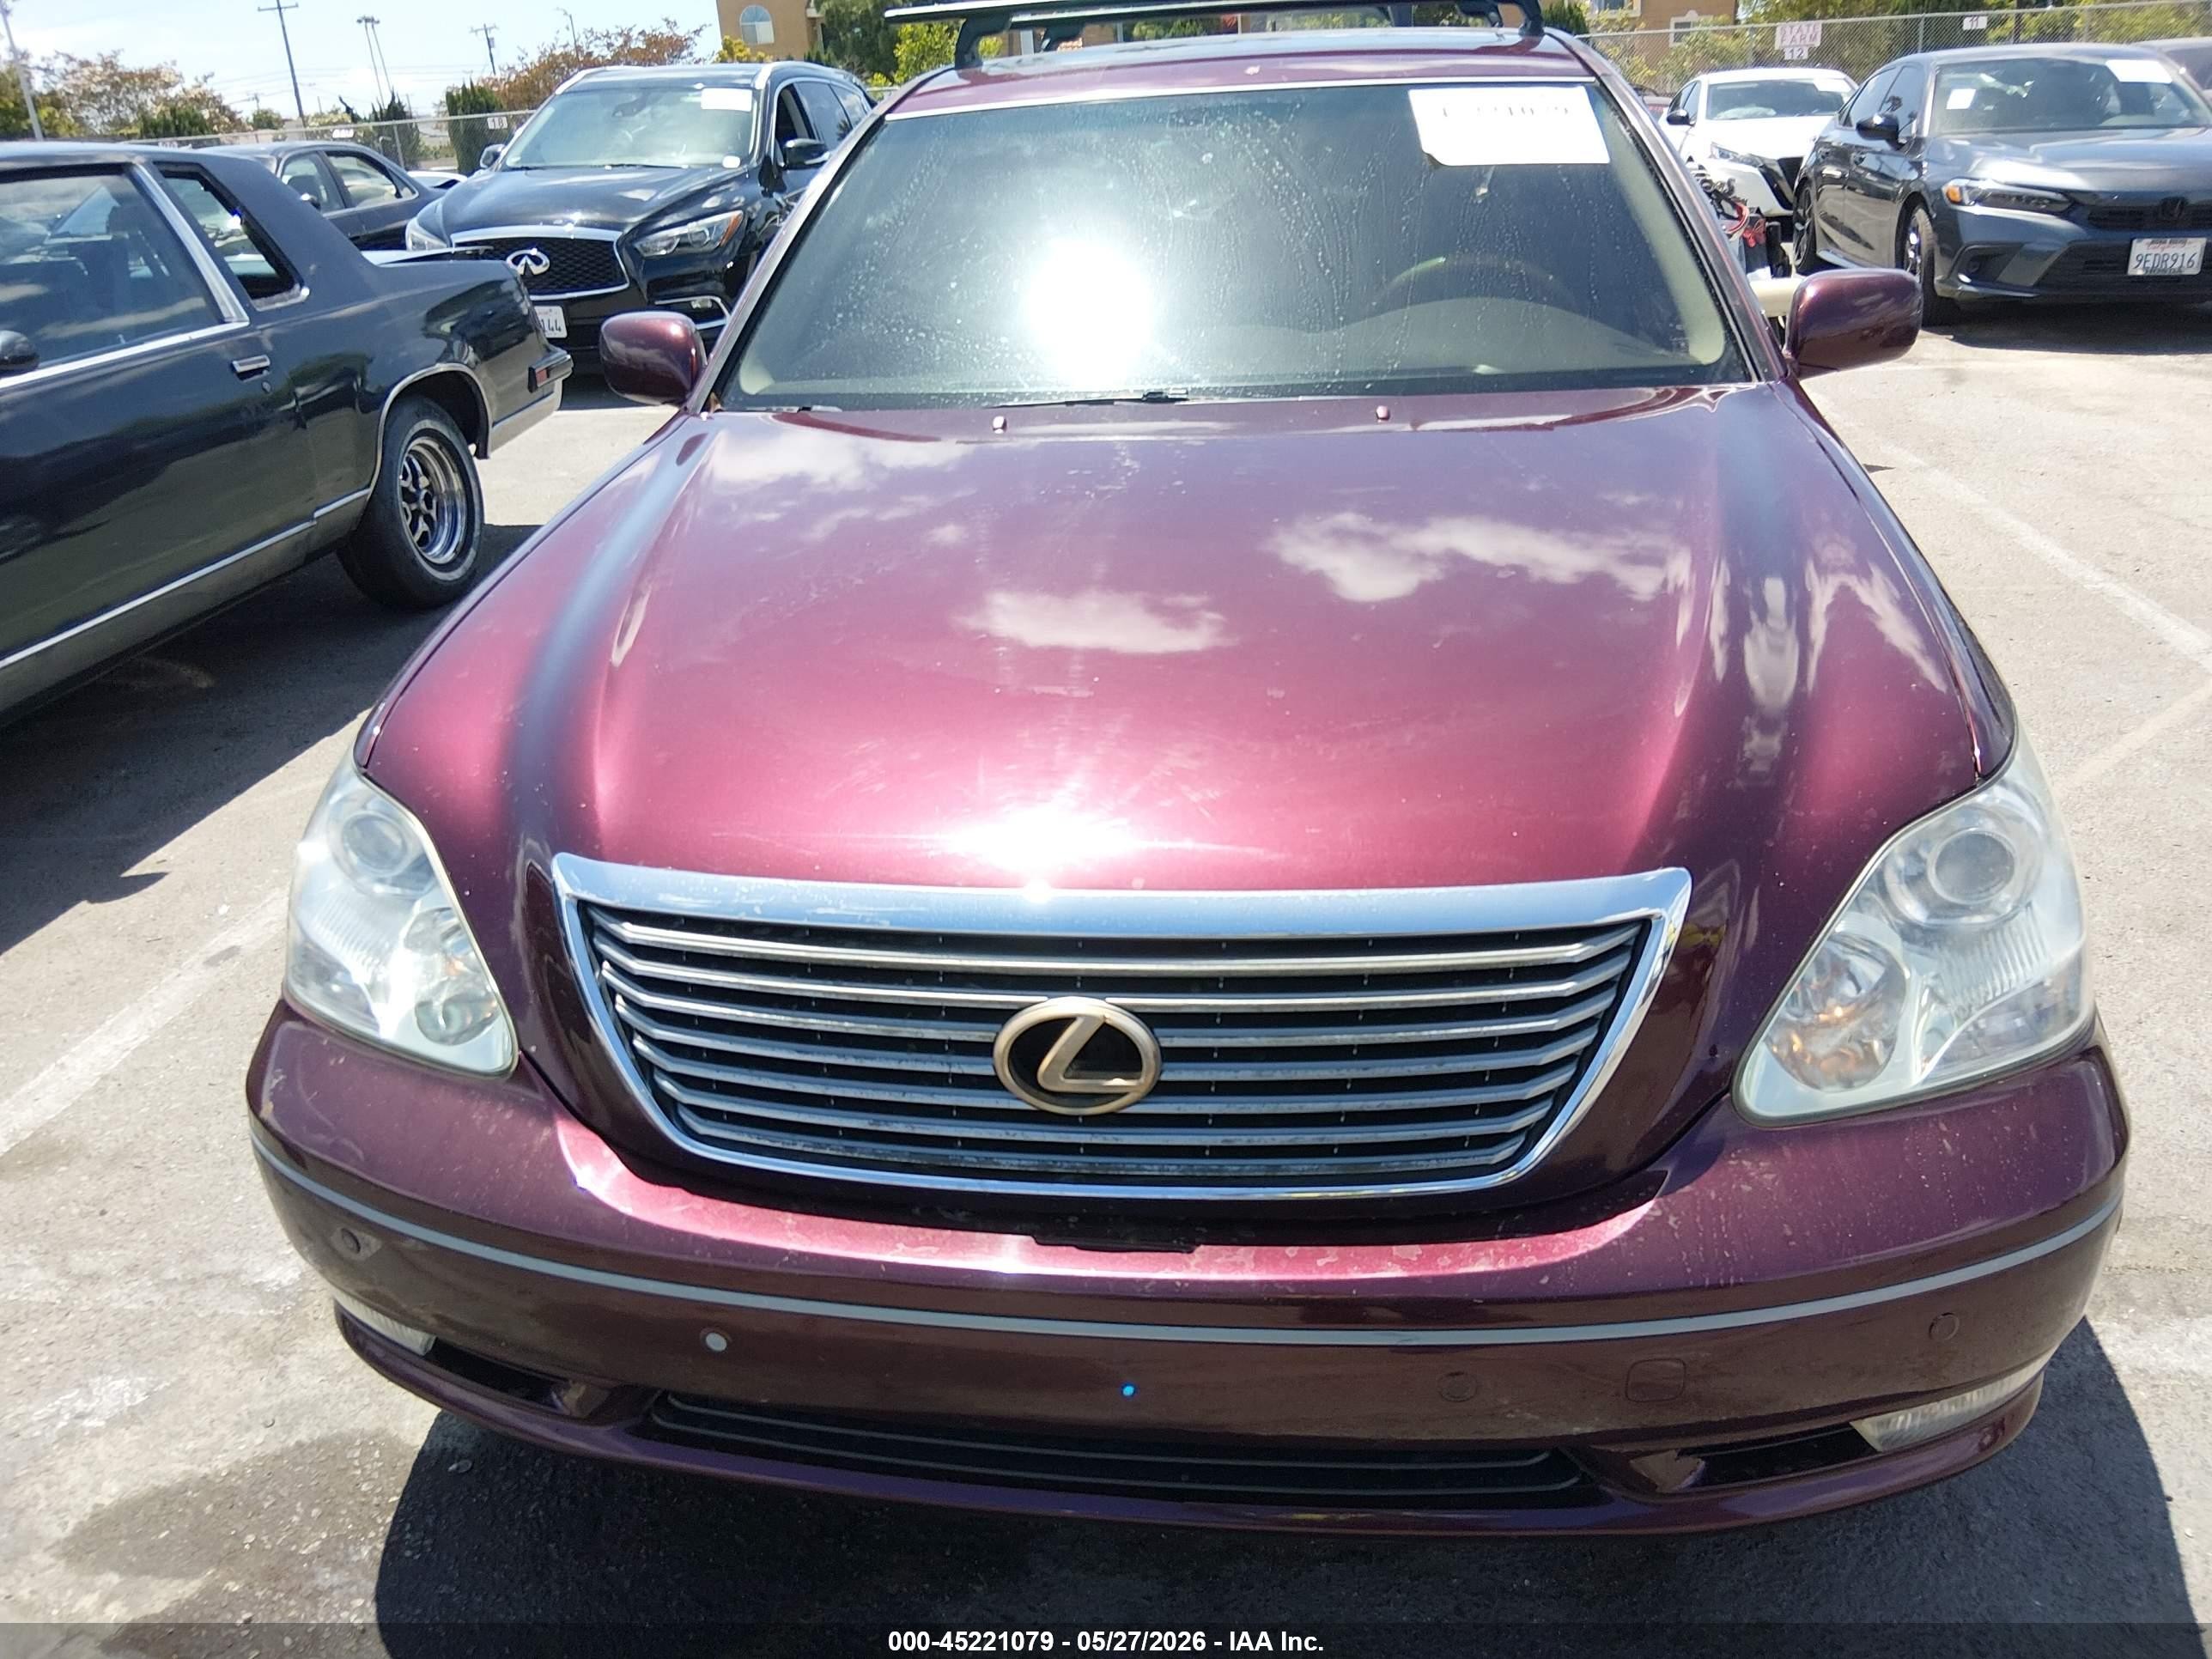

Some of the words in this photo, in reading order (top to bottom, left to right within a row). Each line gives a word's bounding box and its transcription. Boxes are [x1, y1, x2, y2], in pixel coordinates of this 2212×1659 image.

[1780, 22, 1820, 35] STATE
[1780, 33, 1818, 45] FARM
[1789, 47, 1805, 58] 12
[2133, 252, 2197, 269] 9EDR916
